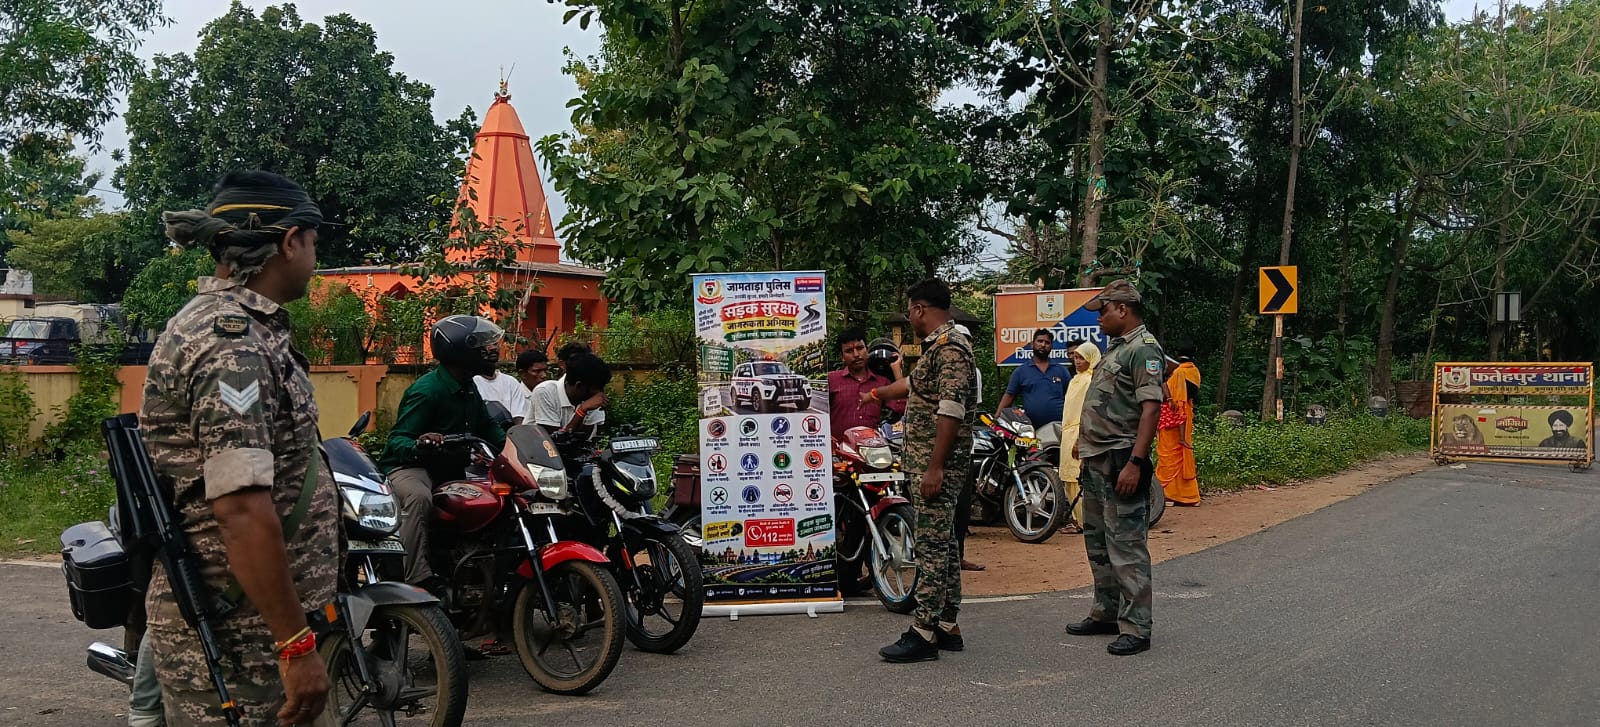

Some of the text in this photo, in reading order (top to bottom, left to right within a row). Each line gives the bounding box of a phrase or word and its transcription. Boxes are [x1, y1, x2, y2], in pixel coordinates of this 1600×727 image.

[726, 280, 764, 292] जामताड़ा
[766, 278, 791, 294] पुलिस
[724, 302, 798, 318] सड़क सुरक्षा
[727, 318, 795, 330] जागरूकता अभियान
[1000, 322, 1102, 344] थाना तेहपर
[1015, 346, 1034, 359] जिल
[1472, 370, 1585, 386] फतेहपुर थाना
[762, 532, 778, 542] 112
